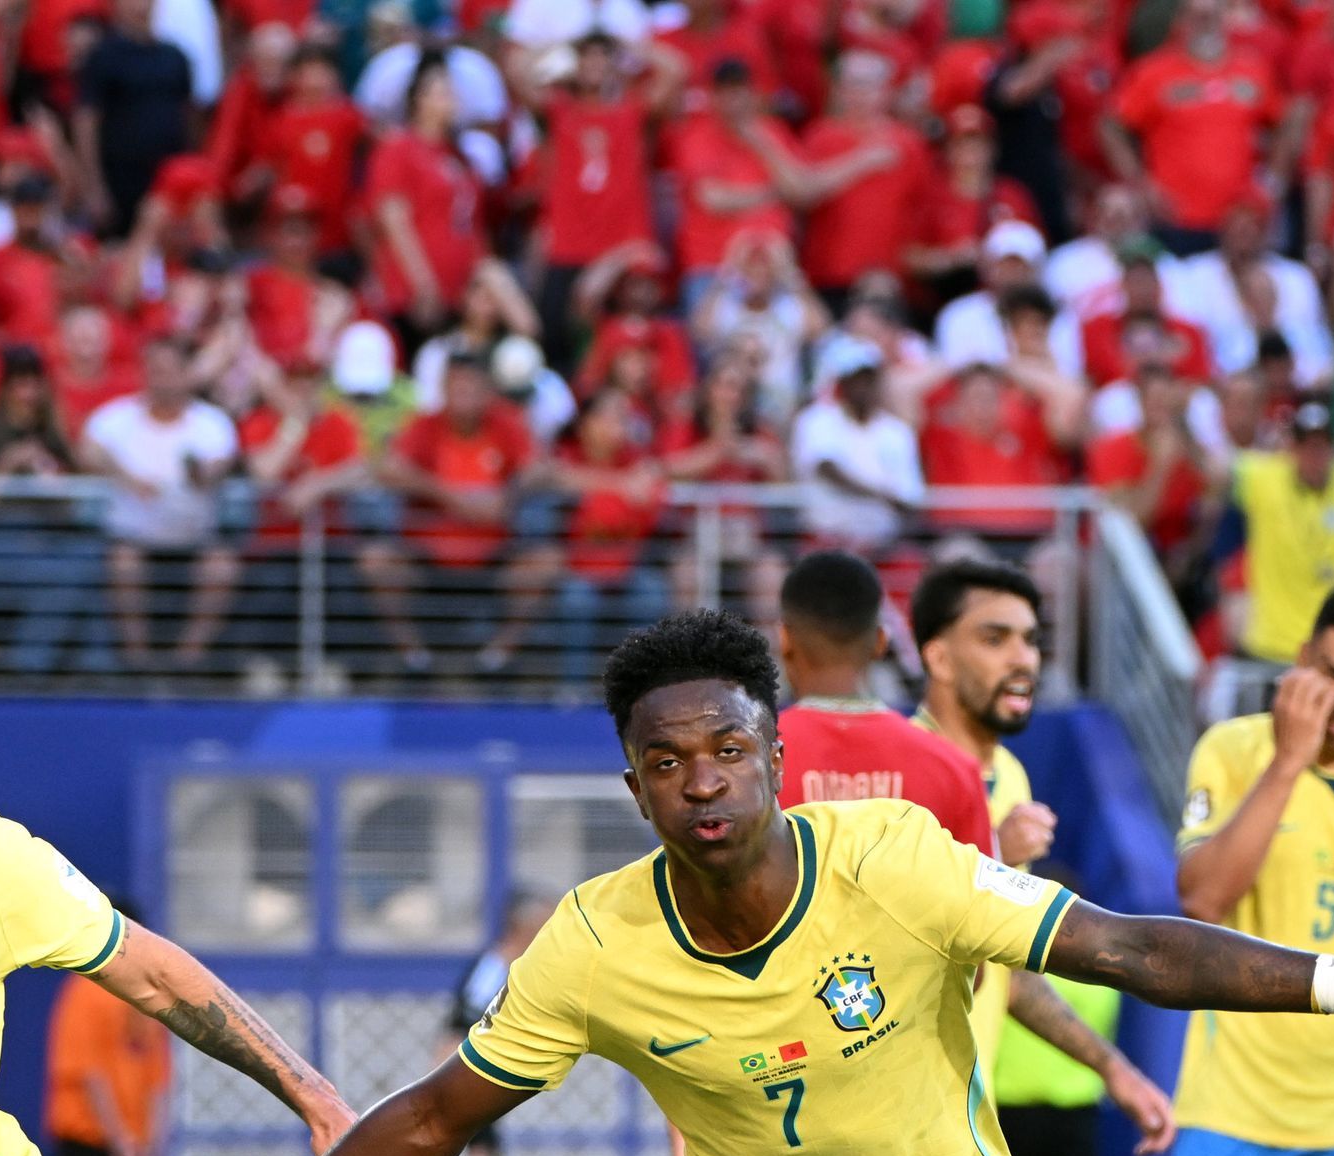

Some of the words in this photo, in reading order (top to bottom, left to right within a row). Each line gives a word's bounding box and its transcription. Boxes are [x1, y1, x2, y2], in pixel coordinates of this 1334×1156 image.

[842, 990, 864, 1007] CBF
[841, 1019, 900, 1059] BRASIL
[763, 1078, 805, 1147] 7
